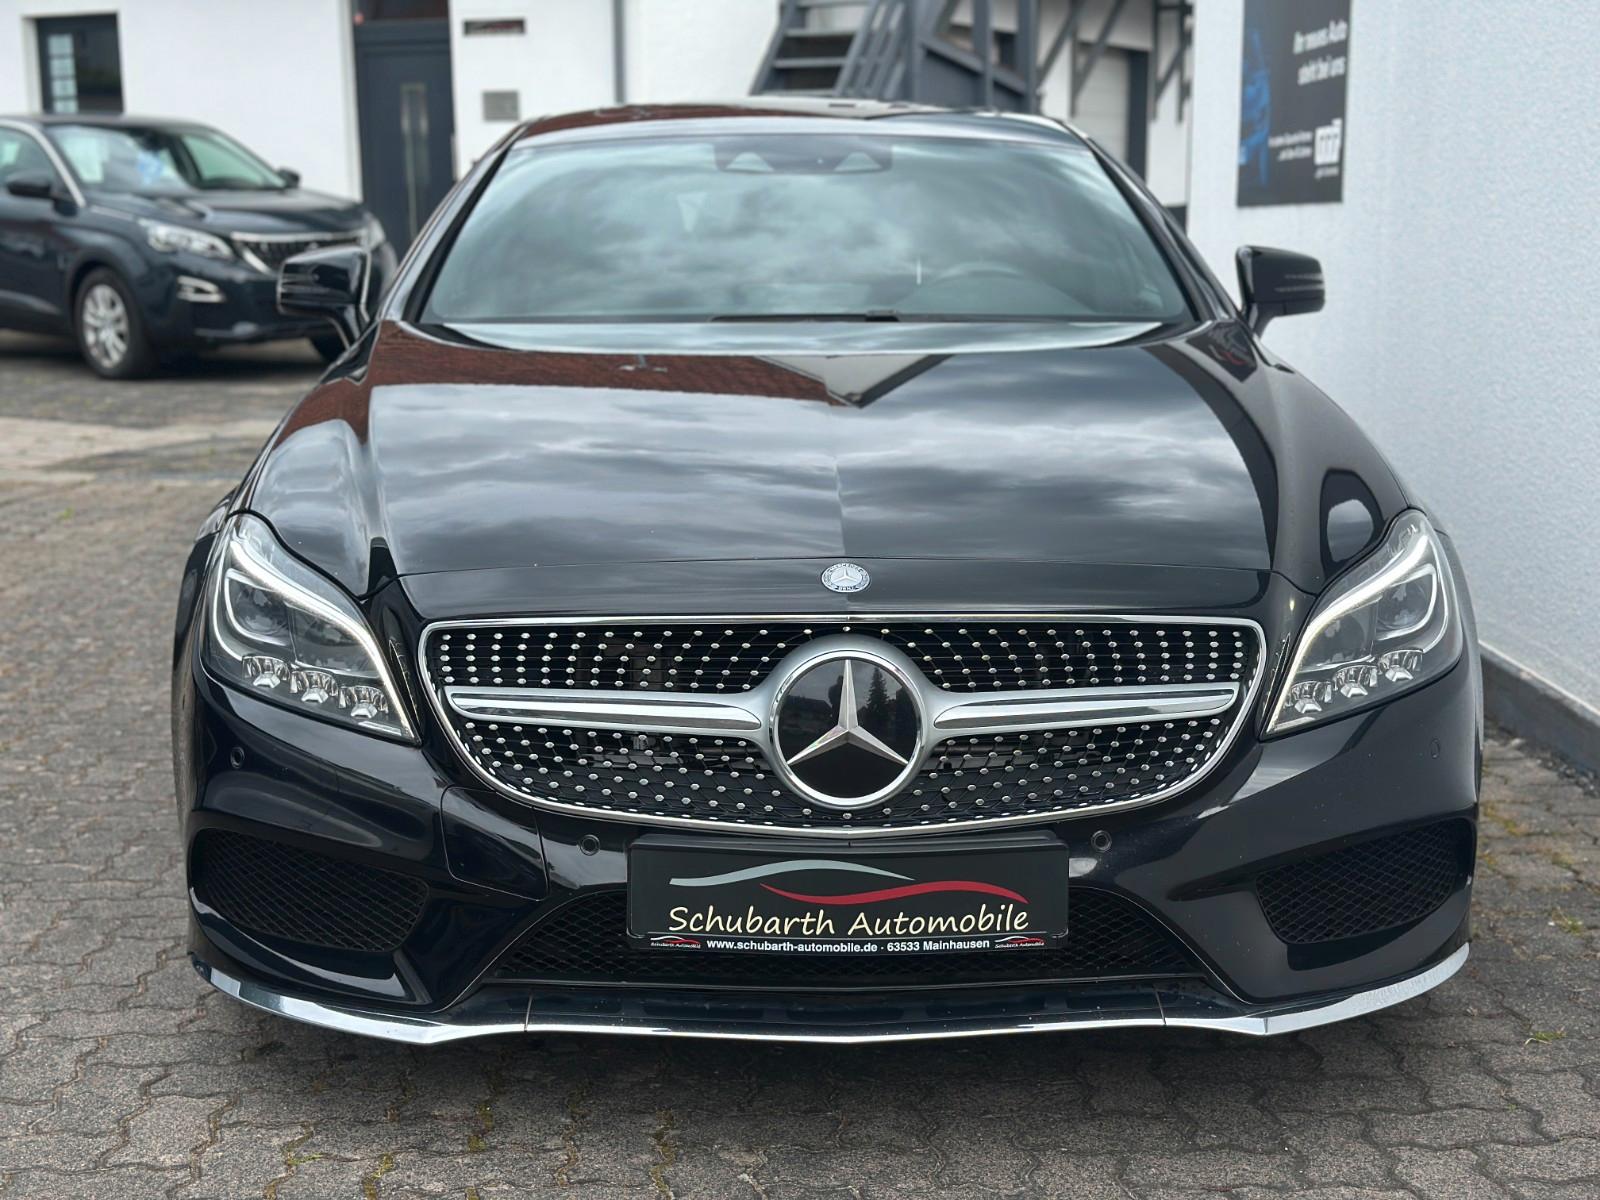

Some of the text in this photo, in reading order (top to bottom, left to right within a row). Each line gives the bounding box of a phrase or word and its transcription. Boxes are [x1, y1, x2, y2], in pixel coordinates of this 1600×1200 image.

[669, 904, 1029, 936] Schubarth Automobile
[706, 940, 878, 952] www.schubarth-automobile.de
[887, 941, 920, 952] 63533
[923, 940, 990, 951] Mainhausen
